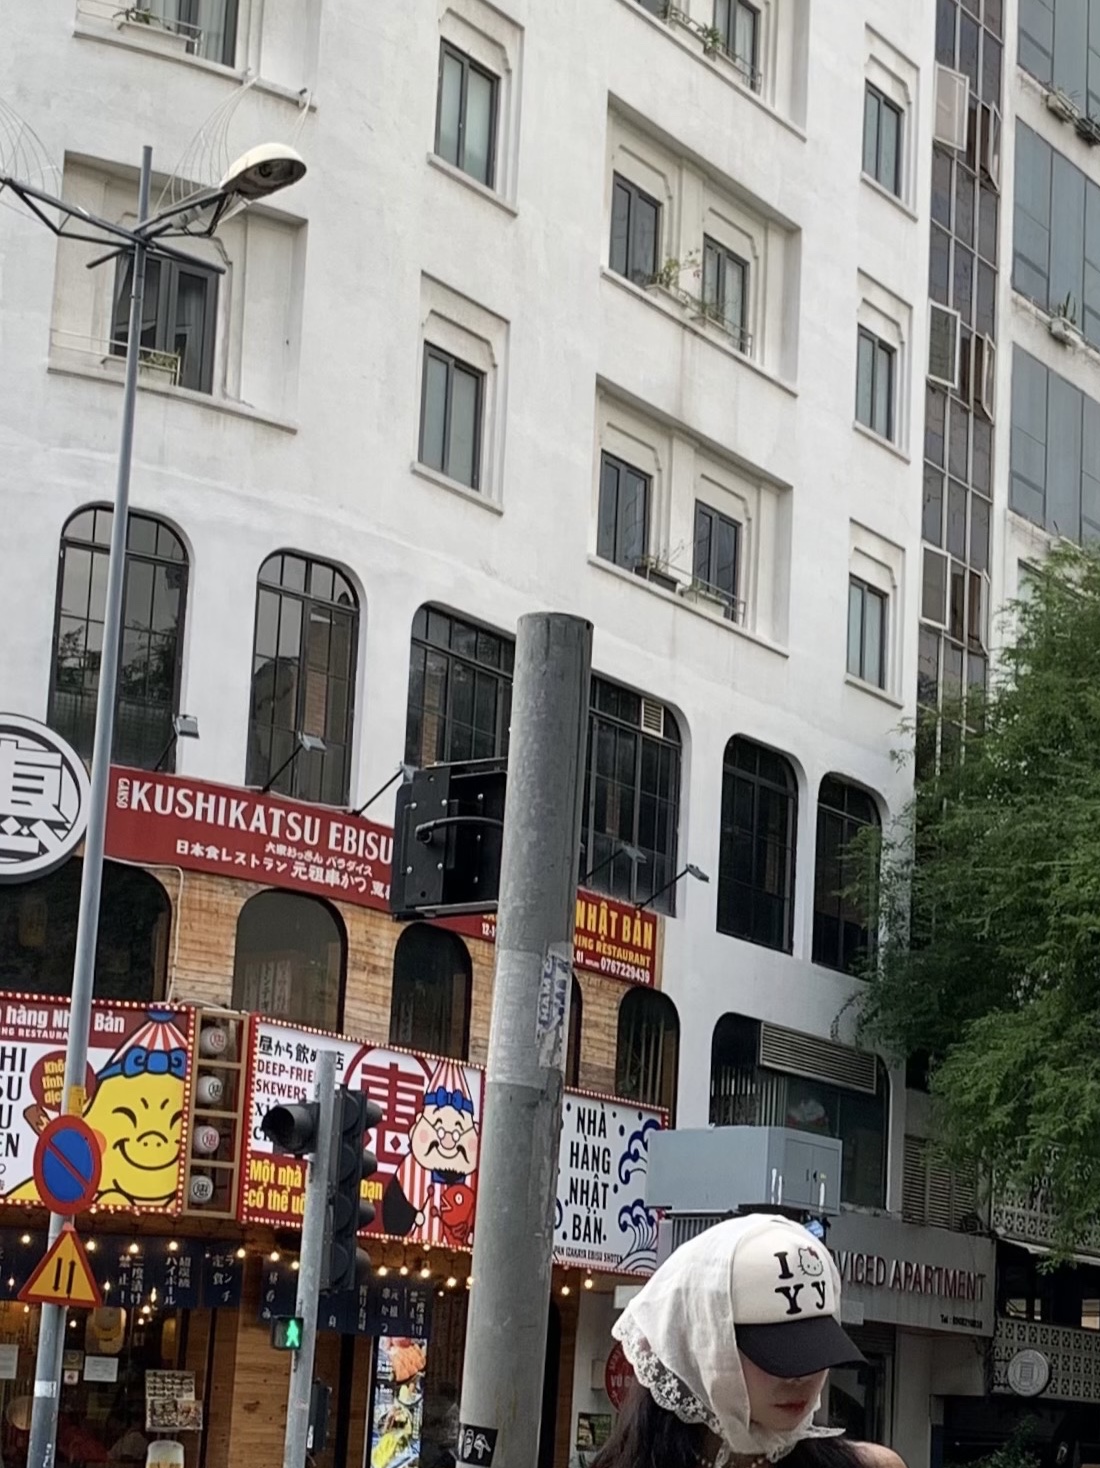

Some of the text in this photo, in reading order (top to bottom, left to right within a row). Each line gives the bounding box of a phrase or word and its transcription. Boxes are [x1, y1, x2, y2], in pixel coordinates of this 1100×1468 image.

[116, 778, 130, 809] GANSO
[130, 779, 394, 865] KUSHIKATSU EBISU
[176, 839, 288, 873] 日本食レストラン
[290, 860, 367, 893] 元祖串かつ
[575, 899, 653, 951] NHẬT BẢN
[595, 939, 651, 969] RESTAURANT
[6, 1004, 125, 1034] hàng Nh Bản
[18, 1028, 68, 1040] RESTAURA
[258, 1035, 345, 1071] 昼から飲め店
[257, 1059, 315, 1083] DEEP-FRIE
[256, 1079, 307, 1102] SKEWERS
[577, 1103, 607, 1138] NHÀ
[569, 1135, 611, 1175] HÀNG
[249, 1159, 276, 1188] Một
[277, 1165, 303, 1189] nhà
[248, 1186, 265, 1209] có
[267, 1187, 289, 1213] thể
[569, 1173, 609, 1214] NHẬT
[571, 1207, 602, 1244] BẢN
[164, 1256, 178, 1306] ハイボール
[222, 1254, 235, 1302] ランチ
[774, 1251, 794, 1279] I
[832, 1250, 986, 1302] VICED APARTMENT
